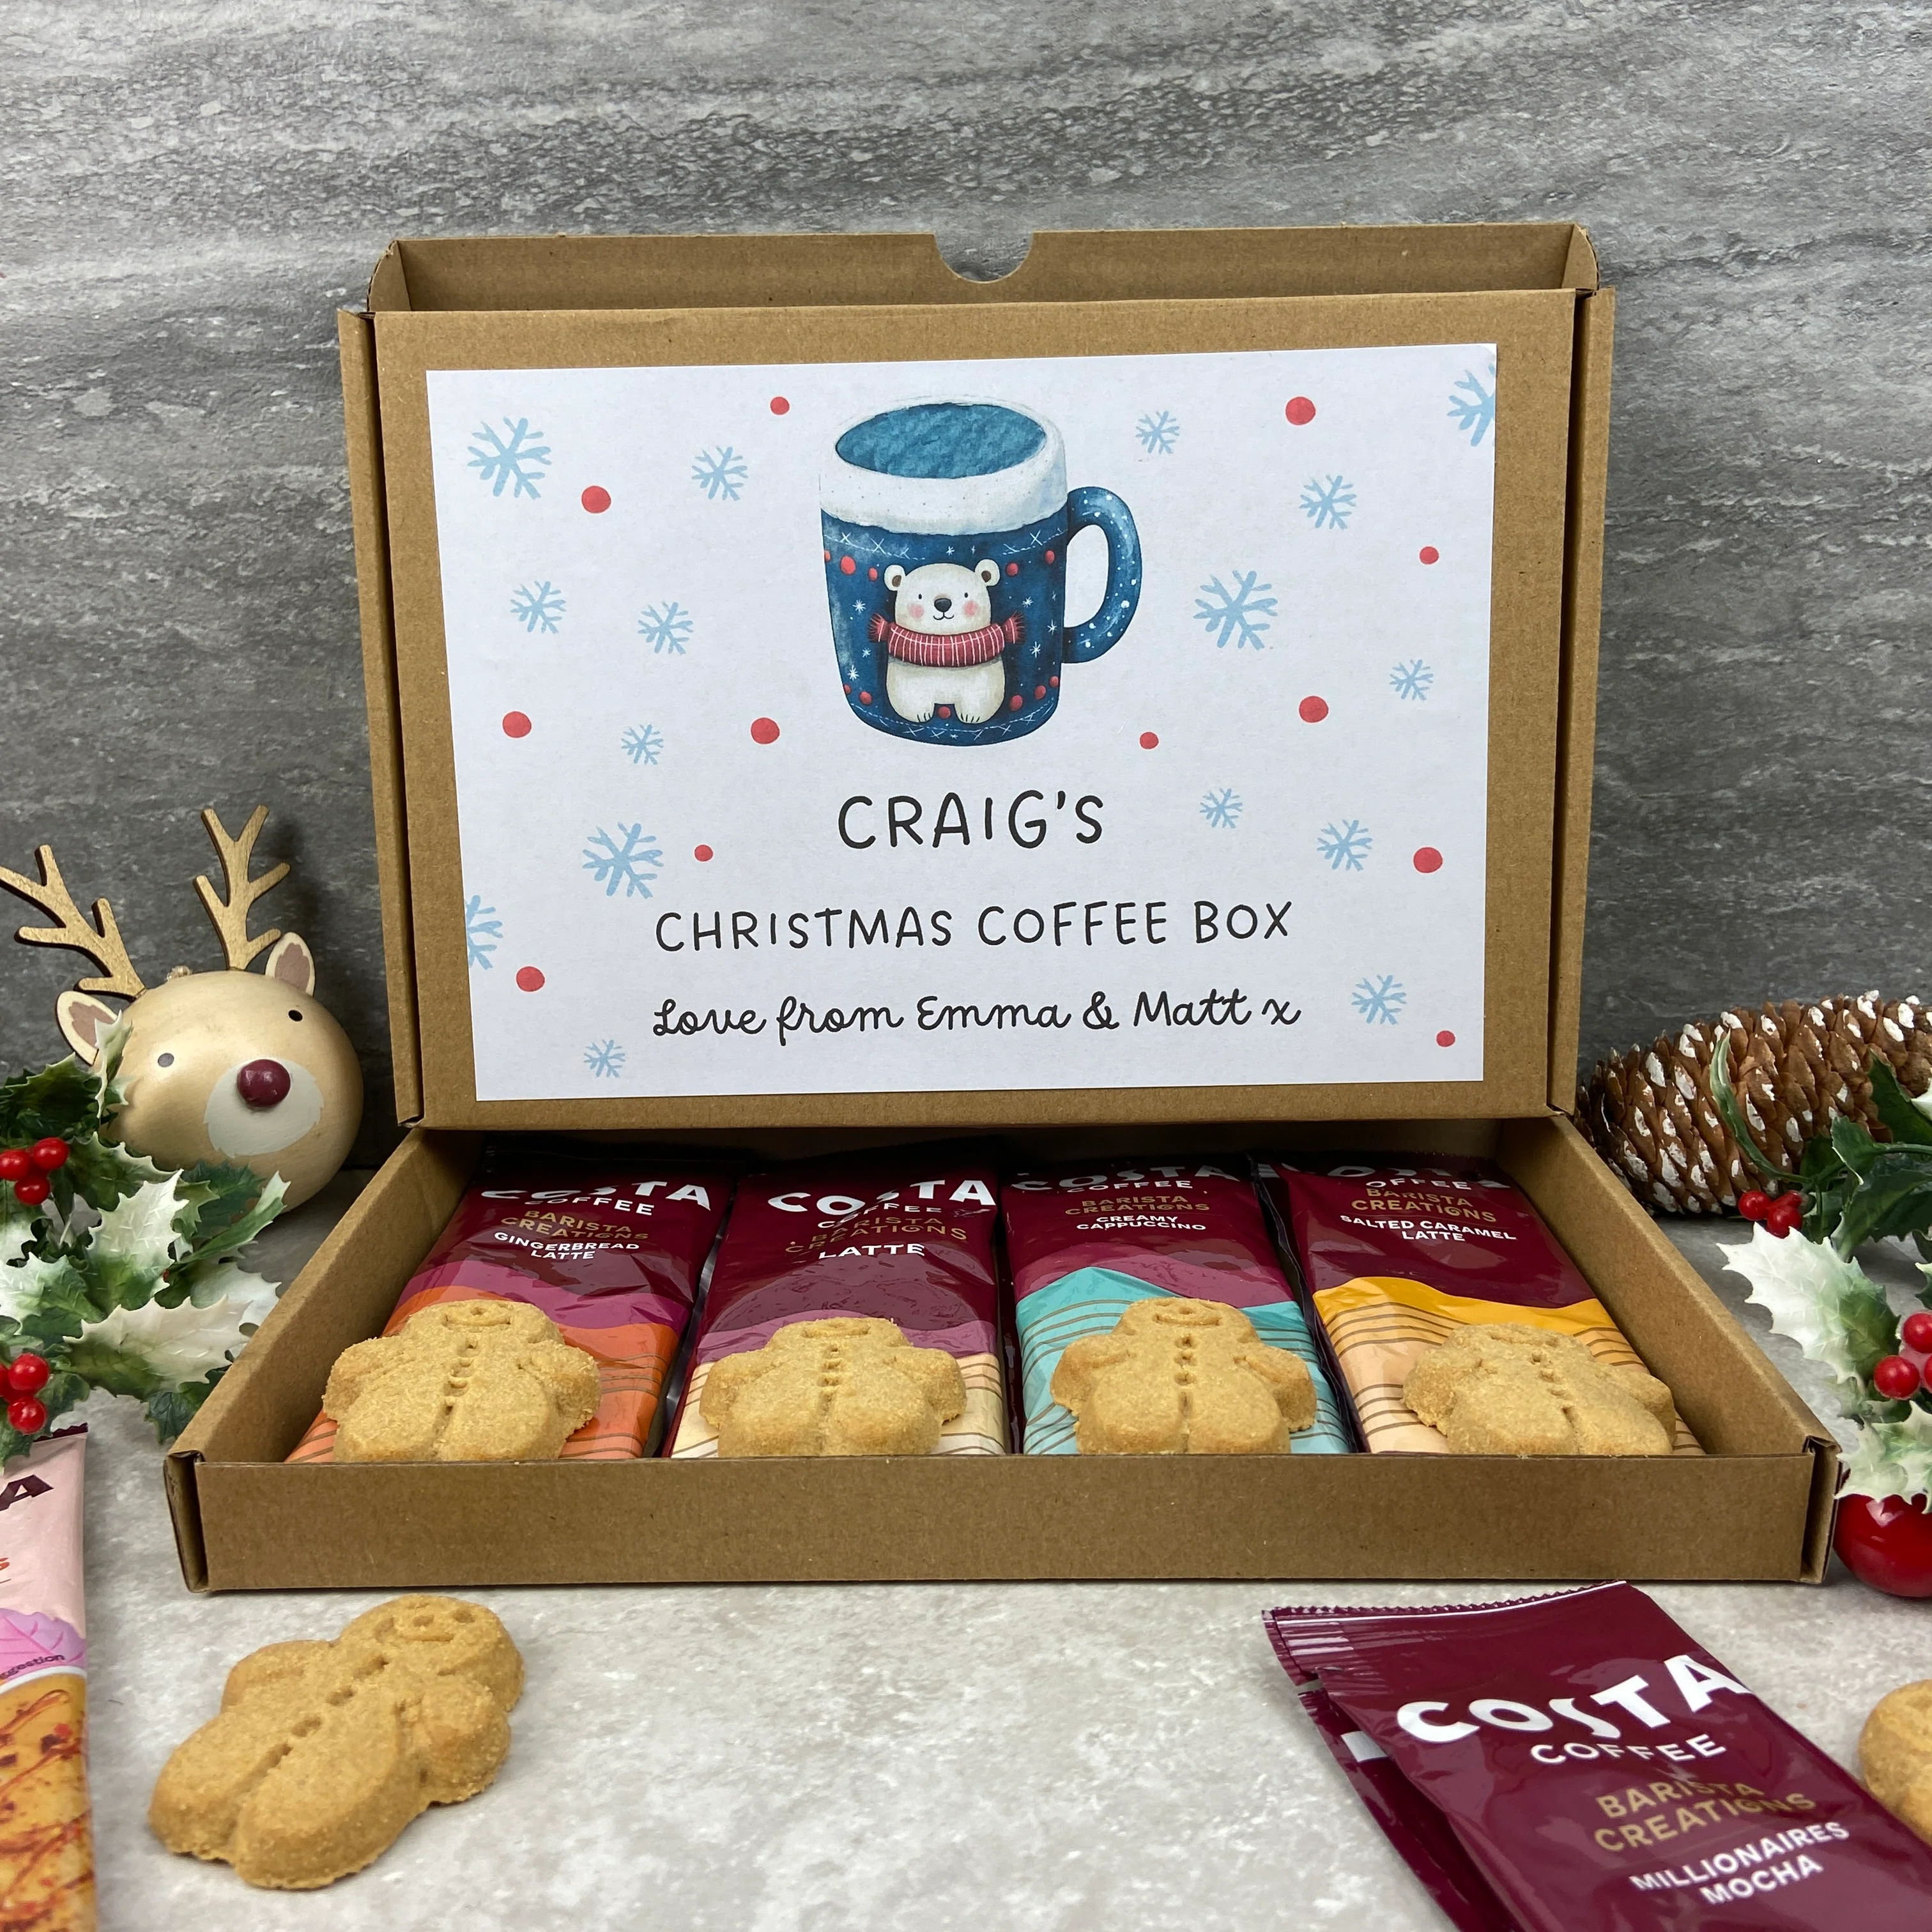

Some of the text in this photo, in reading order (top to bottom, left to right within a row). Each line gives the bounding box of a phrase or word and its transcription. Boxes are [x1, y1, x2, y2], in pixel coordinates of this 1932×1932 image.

[838, 790, 1103, 849] CRAIG'S
[656, 900, 1292, 952] CHRISTMAS COFFEE BOX
[652, 988, 1302, 1046] Love from Emma & Matt x
[1010, 1165, 1241, 1191] COSTA
[1066, 1180, 1193, 1193] COFFEE
[1365, 1177, 1472, 1190] OFFEE
[480, 1180, 712, 1212] COSTA
[524, 1197, 655, 1216] COFFEE
[767, 1179, 997, 1216] COSTA
[1081, 1195, 1190, 1207] BARISTA
[1366, 1187, 1473, 1208] BARISTA
[1064, 1203, 1211, 1215] CREATIONS
[1095, 1215, 1179, 1223] CREAMY
[1351, 1199, 1498, 1223] CREATIONS
[500, 1217, 650, 1239] CREATIONS
[524, 1210, 632, 1232] BARISTA
[1075, 1220, 1207, 1230] CAPPUCCINO
[1340, 1215, 1518, 1241] SALTED CARAMEL
[493, 1232, 640, 1252] GINGERBREAD
[1402, 1230, 1466, 1242] LATTE
[530, 1250, 595, 1260] LATTE
[818, 1243, 926, 1260] LATTE
[1396, 1654, 1754, 1744] COSTA
[1530, 1733, 1727, 1765] COFFEE
[1595, 1781, 1766, 1818] BARISTA
[1594, 1792, 1817, 1852] CREATIONS
[1629, 1821, 1850, 1891] MILLIONAIRES
[1699, 1853, 1825, 1905] MOCHA
